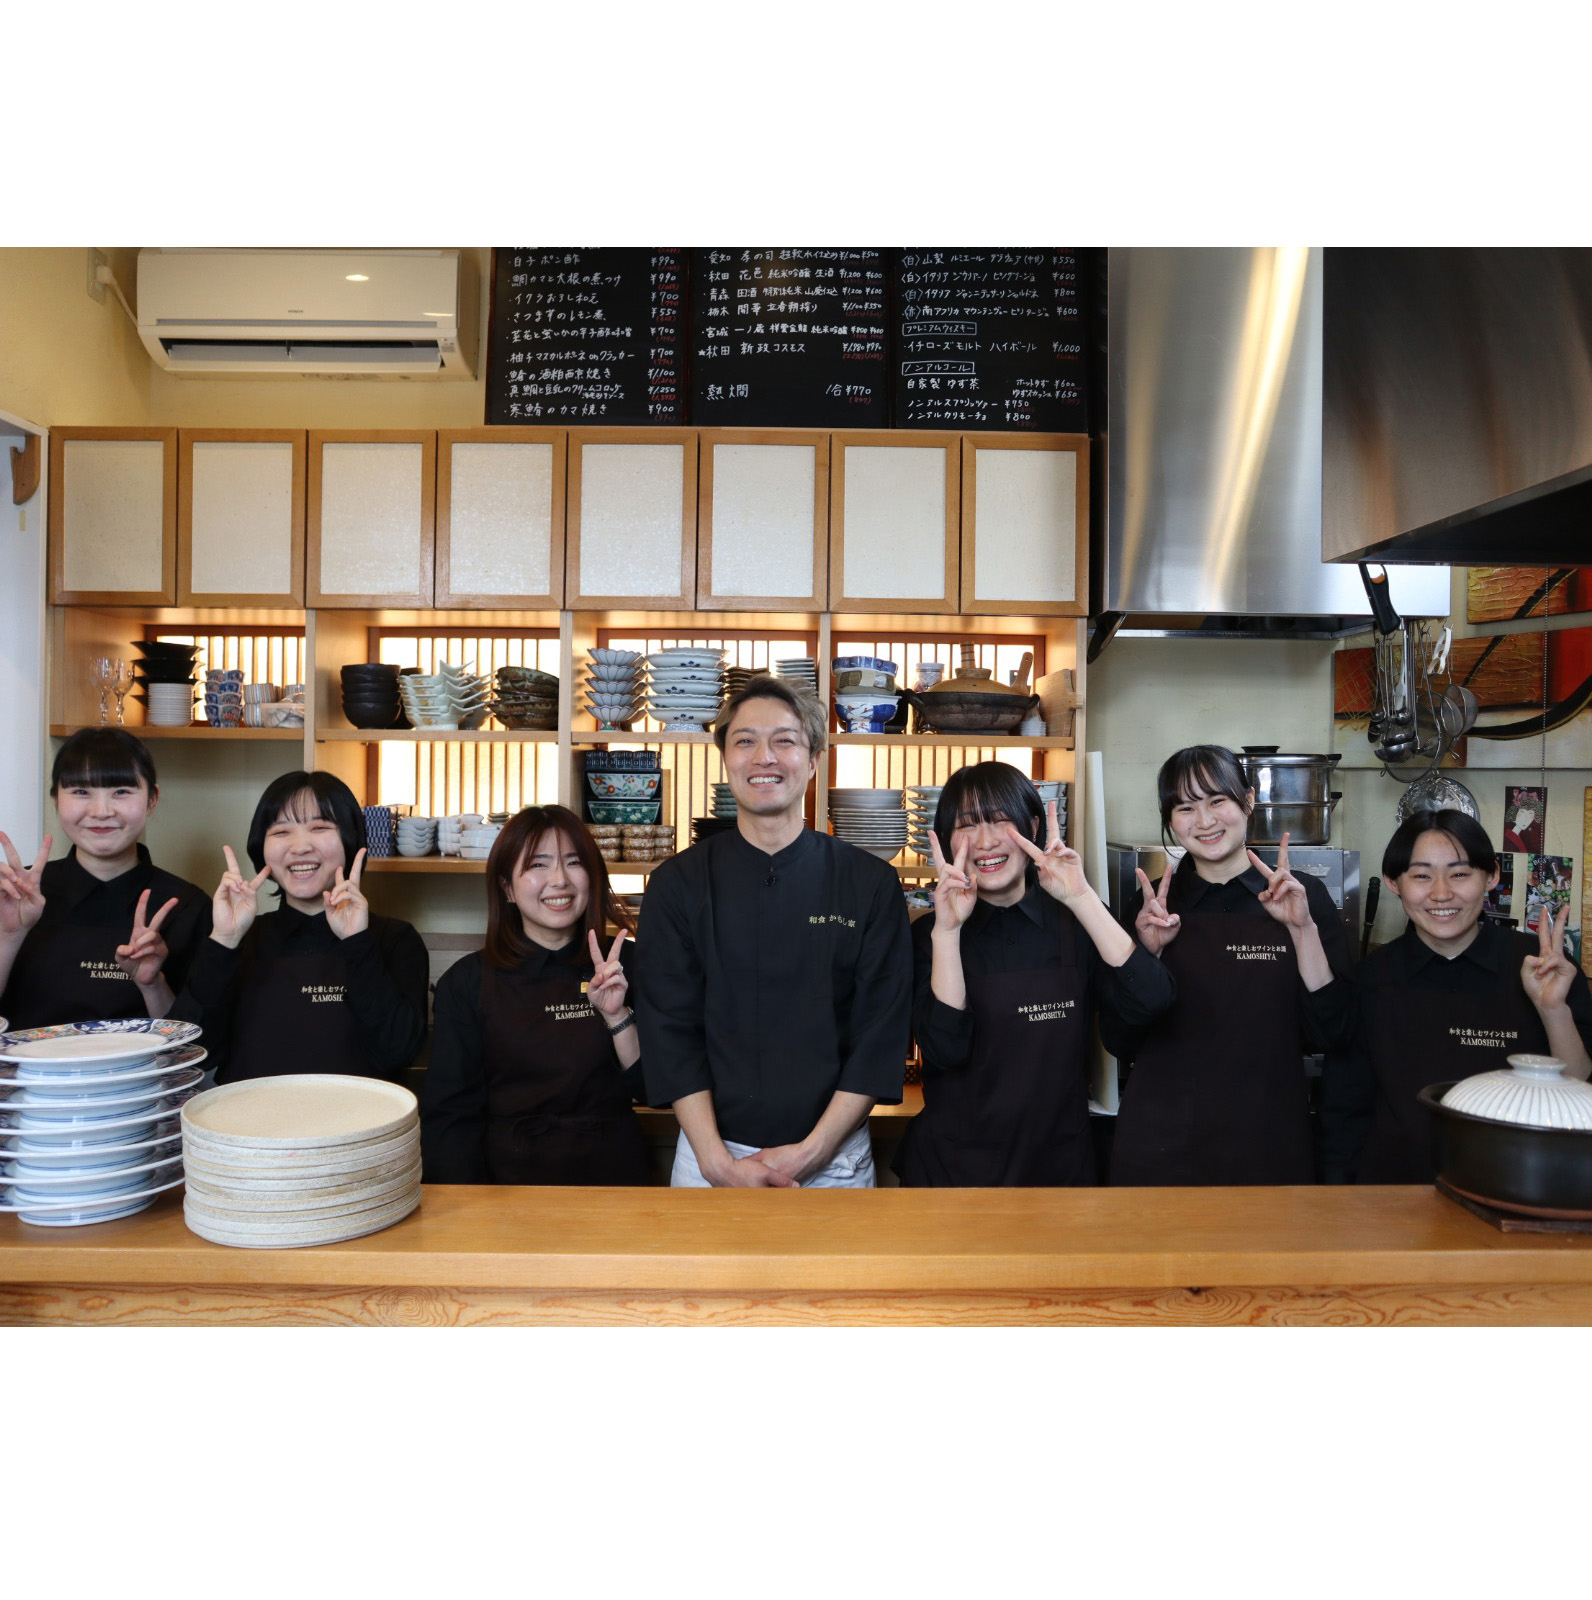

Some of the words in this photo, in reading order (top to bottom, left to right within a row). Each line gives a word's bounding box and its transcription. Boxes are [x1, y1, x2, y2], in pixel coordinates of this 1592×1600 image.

[651, 256, 674, 267] ¥990
[1053, 256, 1075, 265] ¥550
[650, 272, 676, 285] ¥990
[1052, 272, 1075, 280] ¥600
[651, 292, 679, 302] ¥700
[1054, 288, 1075, 297] ¥800
[651, 307, 676, 318] ¥550
[1057, 307, 1077, 315] ¥600
[650, 327, 674, 336] ¥700
[774, 344, 805, 352] コスモス
[990, 342, 1037, 352] ハイボール
[650, 348, 673, 359] ¥700
[1054, 380, 1075, 389] ¥600
[846, 385, 871, 395] ¥770
[1055, 388, 1077, 399] ¥650
[649, 404, 674, 414] ¥900
[1006, 412, 1030, 421] ¥800
[90, 971, 132, 980] KAMOSHIY
[301, 985, 347, 994] 和食と楽しむワイ
[555, 1009, 595, 1020] KAMOSHIYA
[1028, 1010, 1067, 1022] KAMOSHIYA
[1461, 1037, 1505, 1047] KAMOSHIYA
